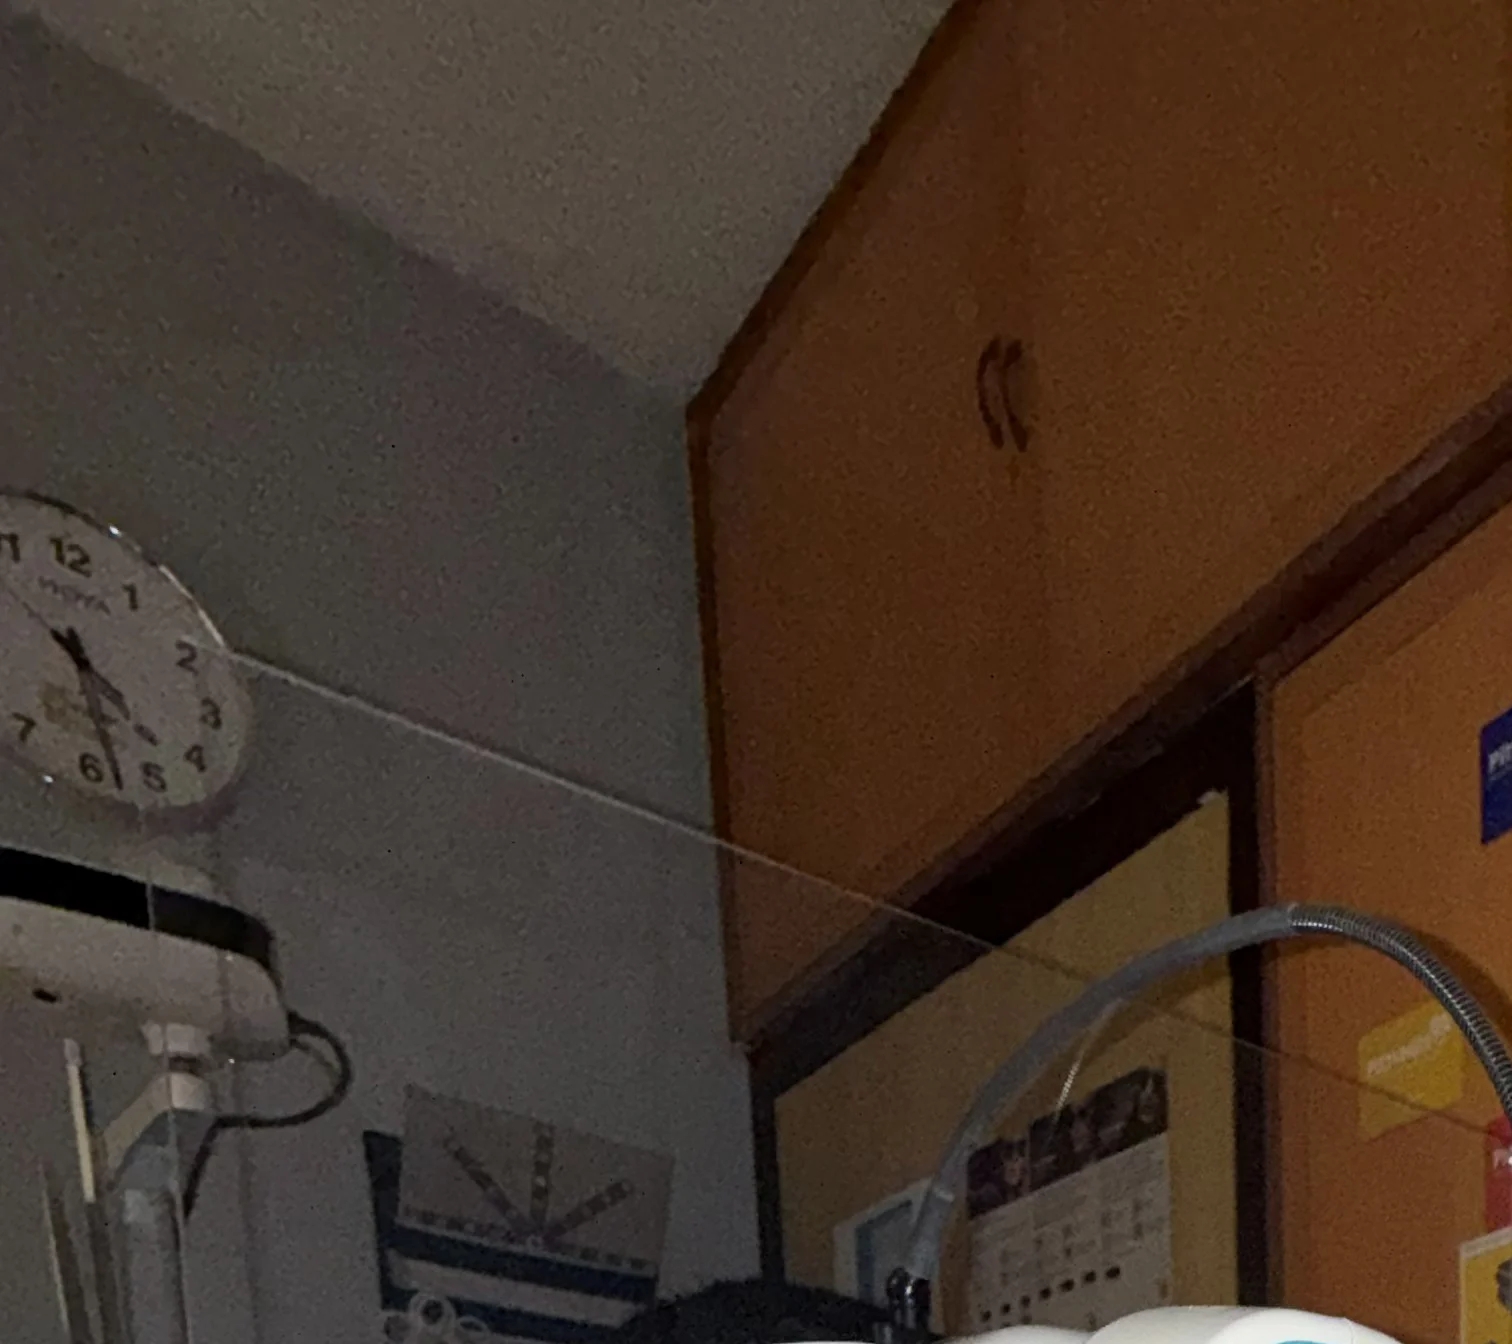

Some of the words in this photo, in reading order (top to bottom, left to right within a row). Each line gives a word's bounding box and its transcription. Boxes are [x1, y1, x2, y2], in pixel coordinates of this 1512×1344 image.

[50, 537, 92, 577] 12
[122, 584, 138, 610] 1
[174, 639, 199, 676] 2
[12, 712, 37, 743] 7
[79, 752, 103, 782] 6
[140, 761, 167, 793] 5
